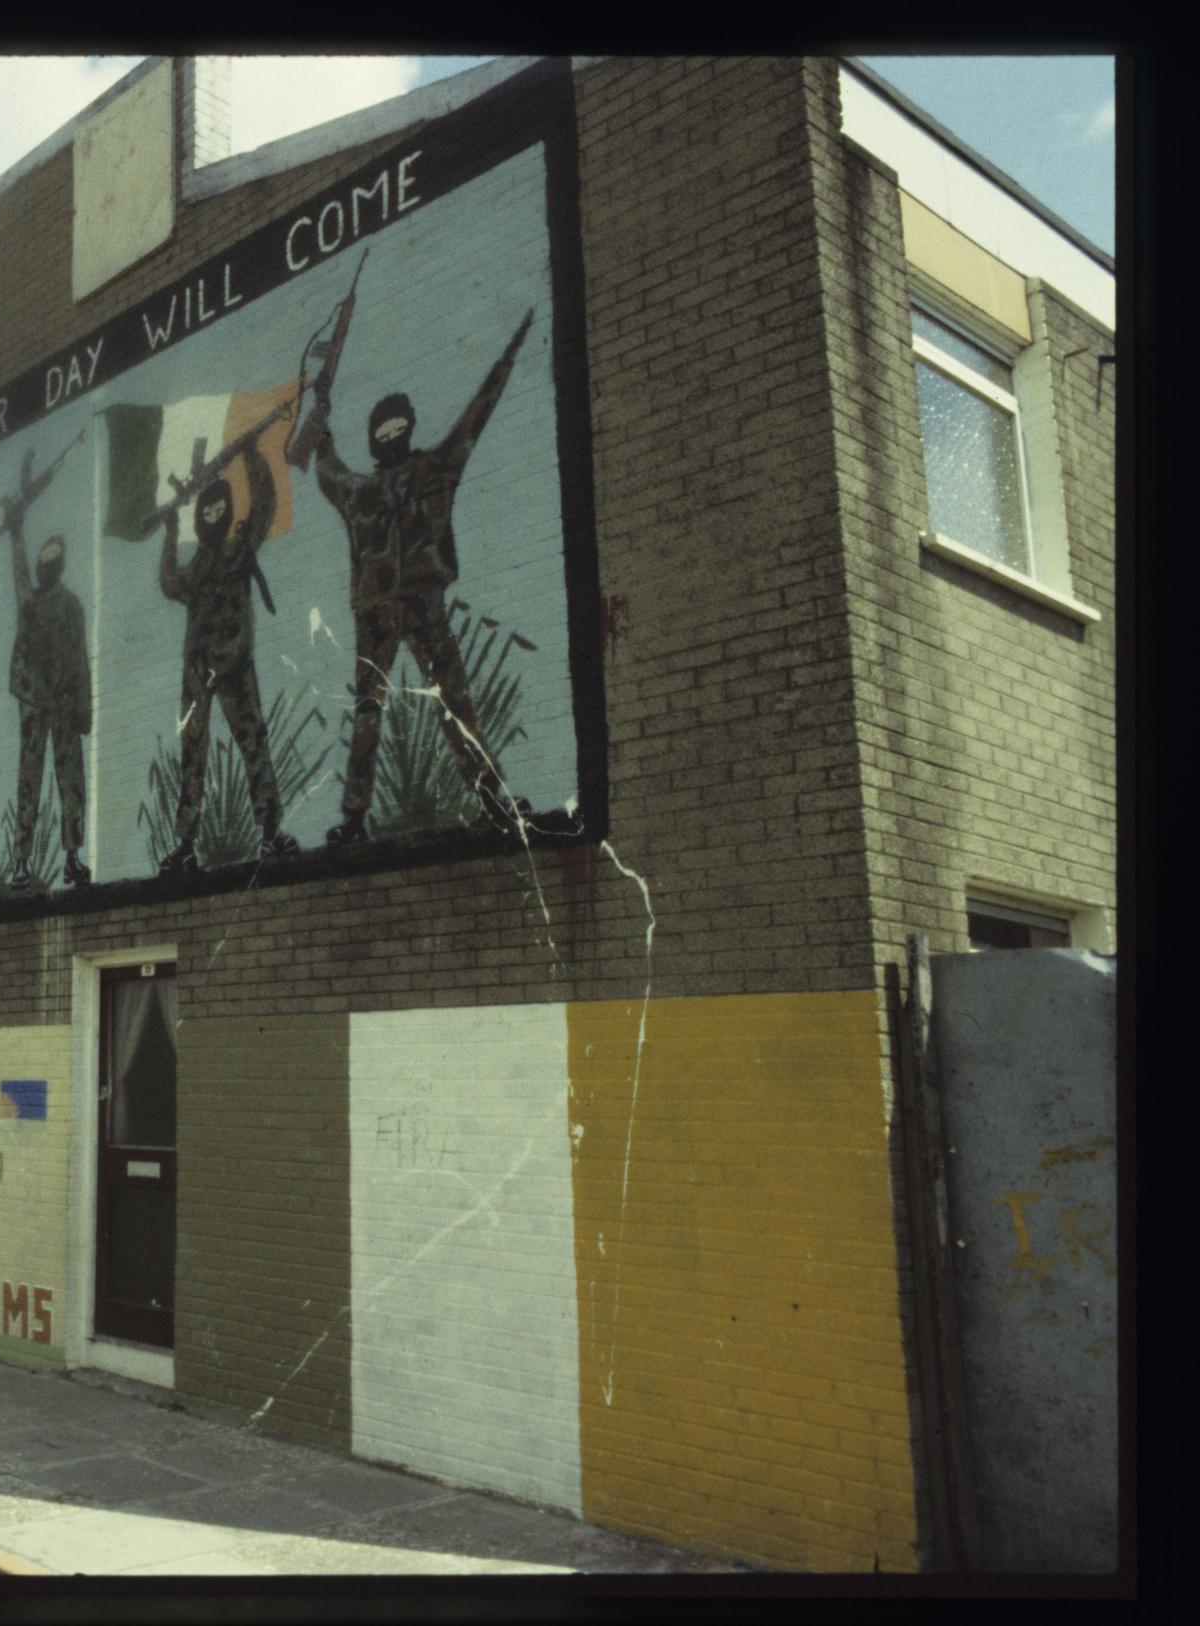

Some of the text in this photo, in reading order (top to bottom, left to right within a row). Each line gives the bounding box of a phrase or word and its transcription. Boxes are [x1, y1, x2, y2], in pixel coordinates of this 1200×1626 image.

[46, 337, 104, 409] DAY
[142, 264, 243, 350] WILL
[285, 150, 423, 271] COME
